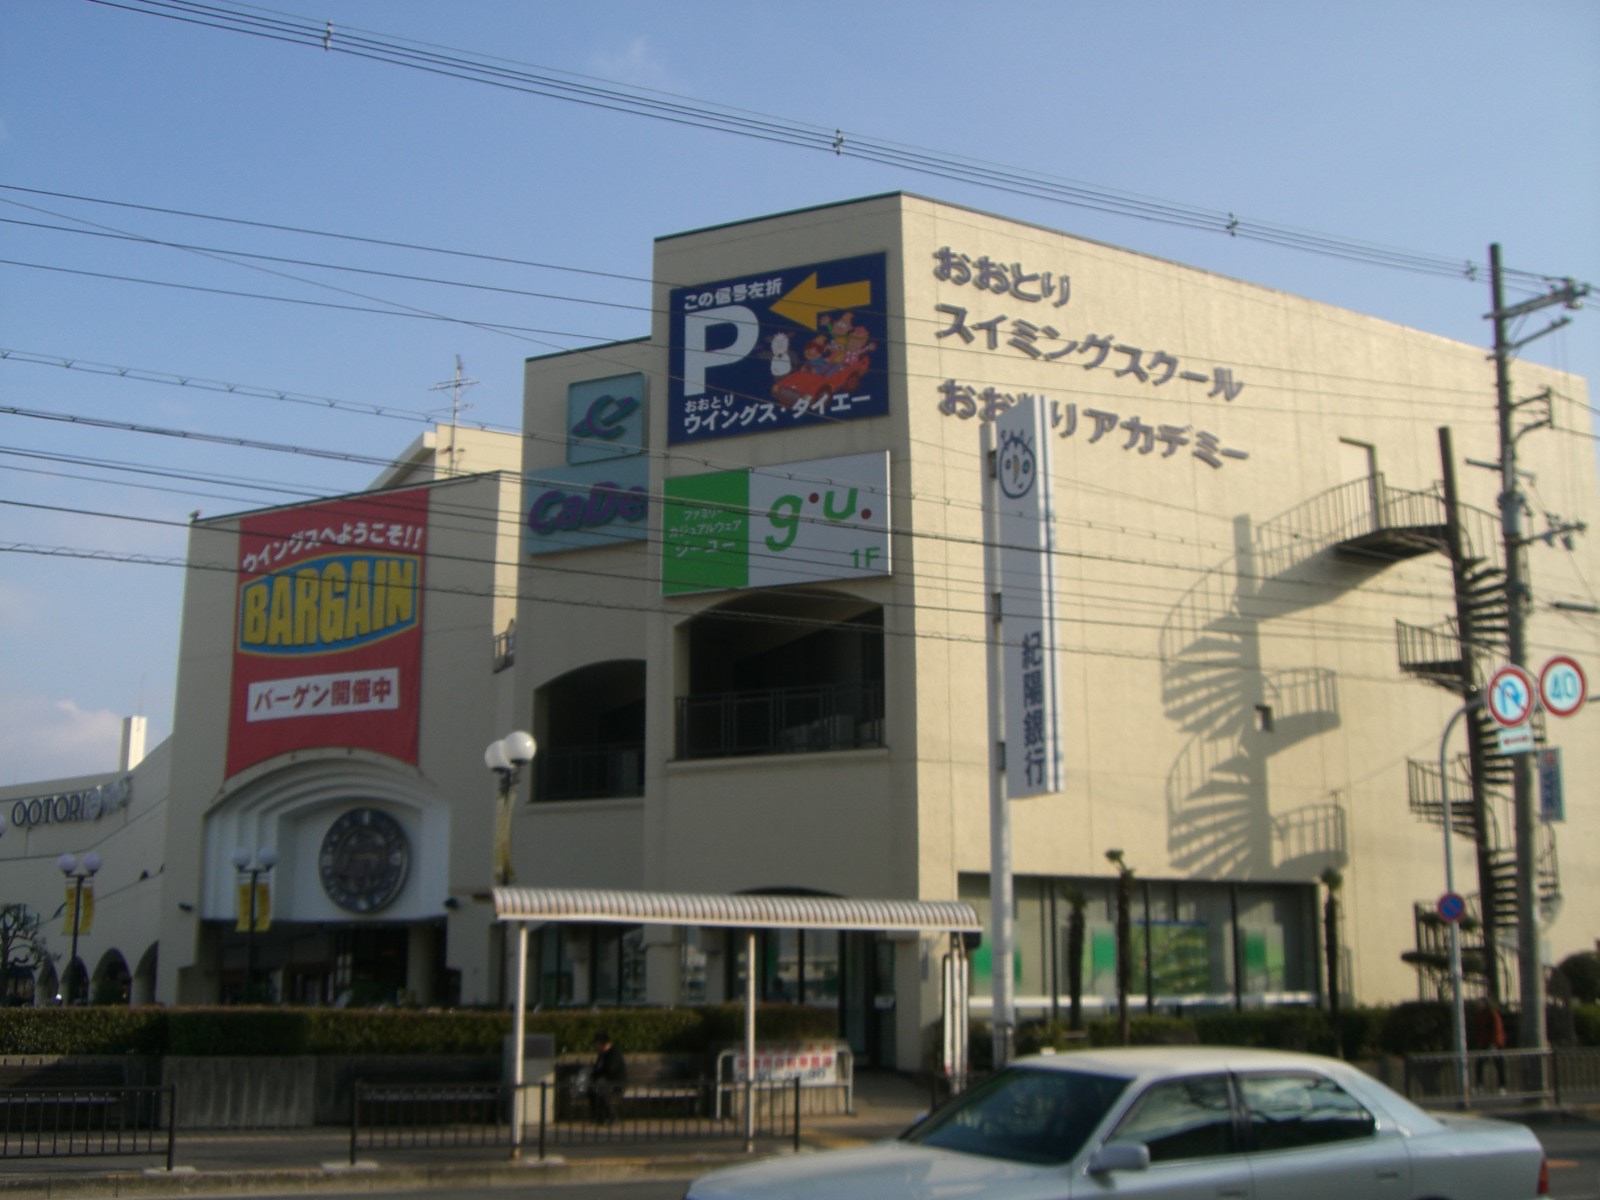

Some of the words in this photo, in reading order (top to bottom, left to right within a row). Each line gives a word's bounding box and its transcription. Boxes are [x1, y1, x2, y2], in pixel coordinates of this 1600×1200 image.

[683, 277, 783, 310] この信号左折
[933, 246, 1070, 308] おおとり
[684, 305, 759, 396] P
[934, 303, 1244, 401] スイミングスクール
[684, 395, 734, 413] おおとり
[937, 378, 1249, 469] おおりアカデミー
[850, 546, 881, 569] 1F
[243, 560, 414, 646] BARGAIN
[254, 678, 391, 712] バーゲン開催中
[1551, 671, 1577, 699] 40
